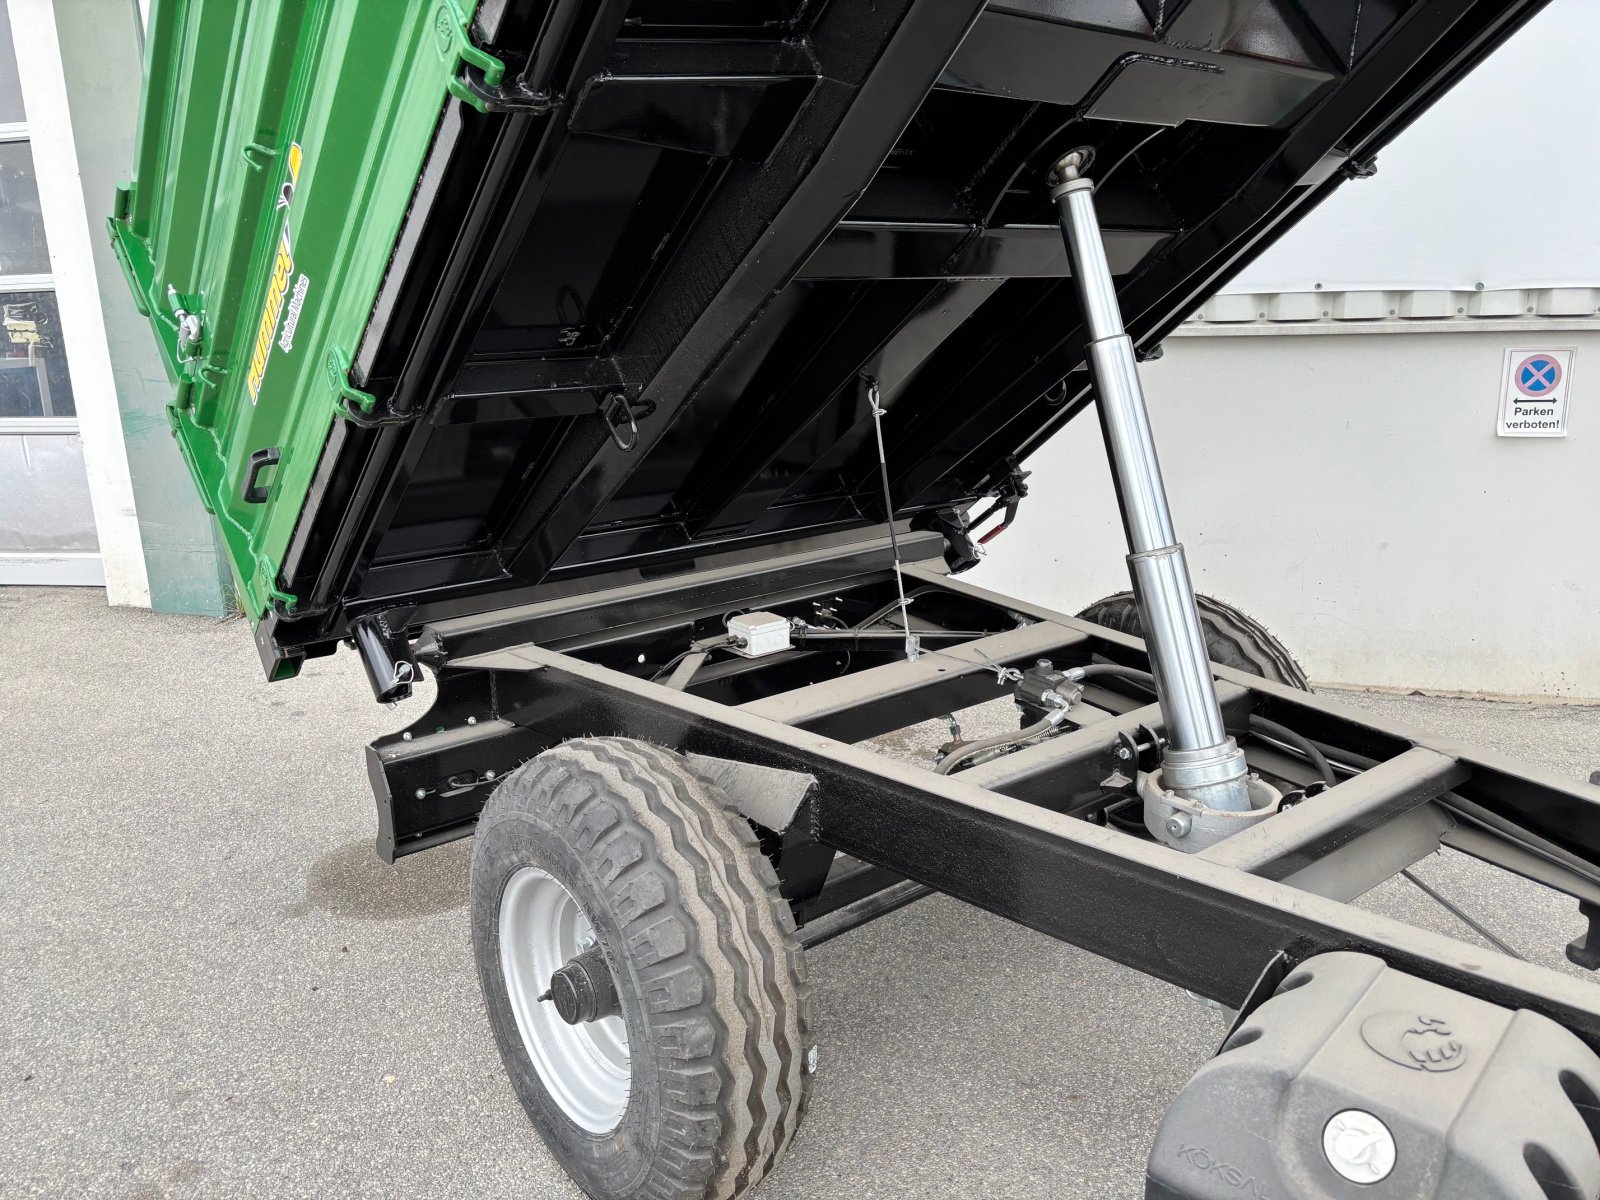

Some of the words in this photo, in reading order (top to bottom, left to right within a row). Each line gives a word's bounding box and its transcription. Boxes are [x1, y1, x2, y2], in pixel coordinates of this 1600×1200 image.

[281, 311, 298, 351] Agricultural
[291, 276, 308, 311] Machines
[1514, 406, 1554, 416] Parken
[1505, 419, 1560, 429] verboten!
